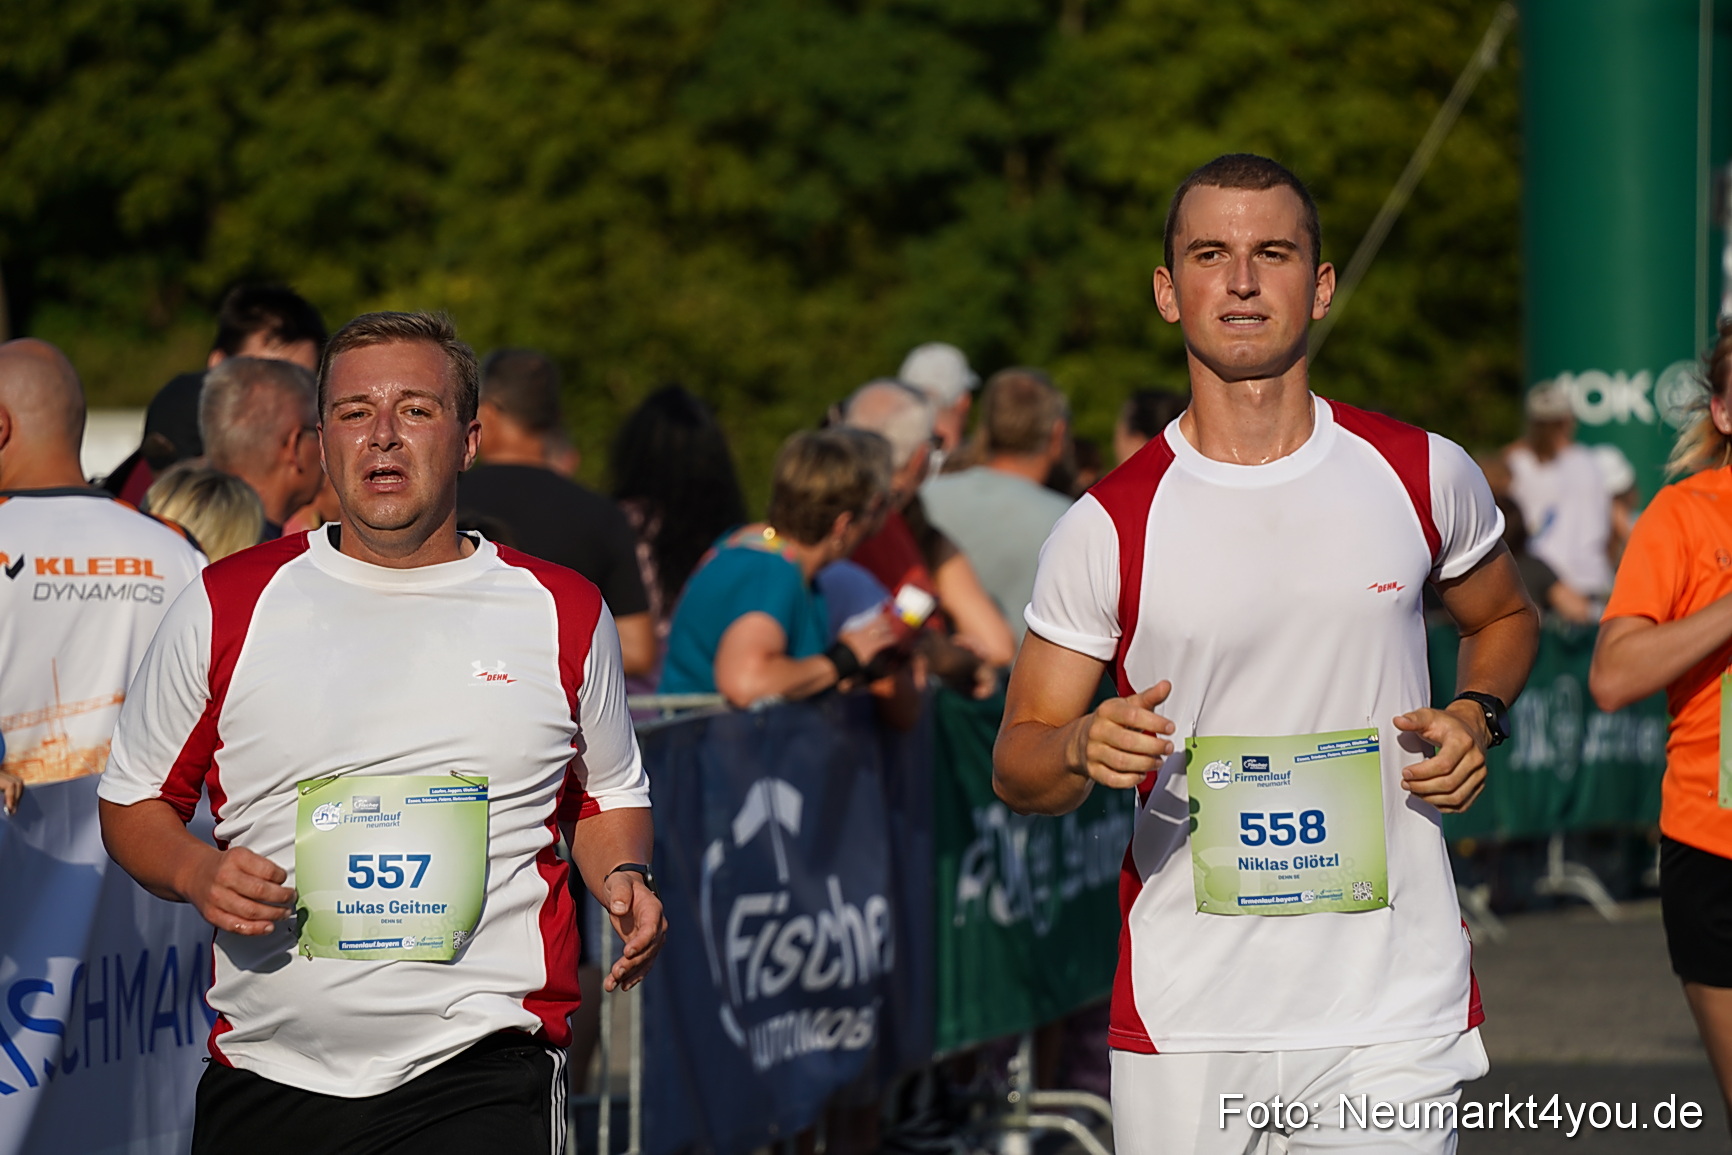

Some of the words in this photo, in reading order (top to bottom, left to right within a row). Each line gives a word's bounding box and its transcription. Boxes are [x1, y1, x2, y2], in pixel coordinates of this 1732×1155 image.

[35, 557, 164, 580] KLEBL
[1377, 581, 1398, 593] DEHN
[33, 582, 165, 605] DYNAMICS
[486, 673, 508, 681] DEHN
[1234, 770, 1292, 782] Firmenlauf
[1257, 780, 1291, 788] neumarkt
[343, 811, 401, 823] Firmenlauf
[366, 820, 400, 829] neumarkt
[1239, 809, 1327, 847] 558
[1238, 857, 1289, 871] Niklas
[1293, 853, 1339, 870] Glötzl
[347, 854, 432, 890] 557
[1240, 896, 1299, 905] firmenlauf.bayern
[336, 900, 385, 914] Lukas
[389, 900, 448, 914] Geitner
[341, 941, 400, 949] firmenlauf.bayern
